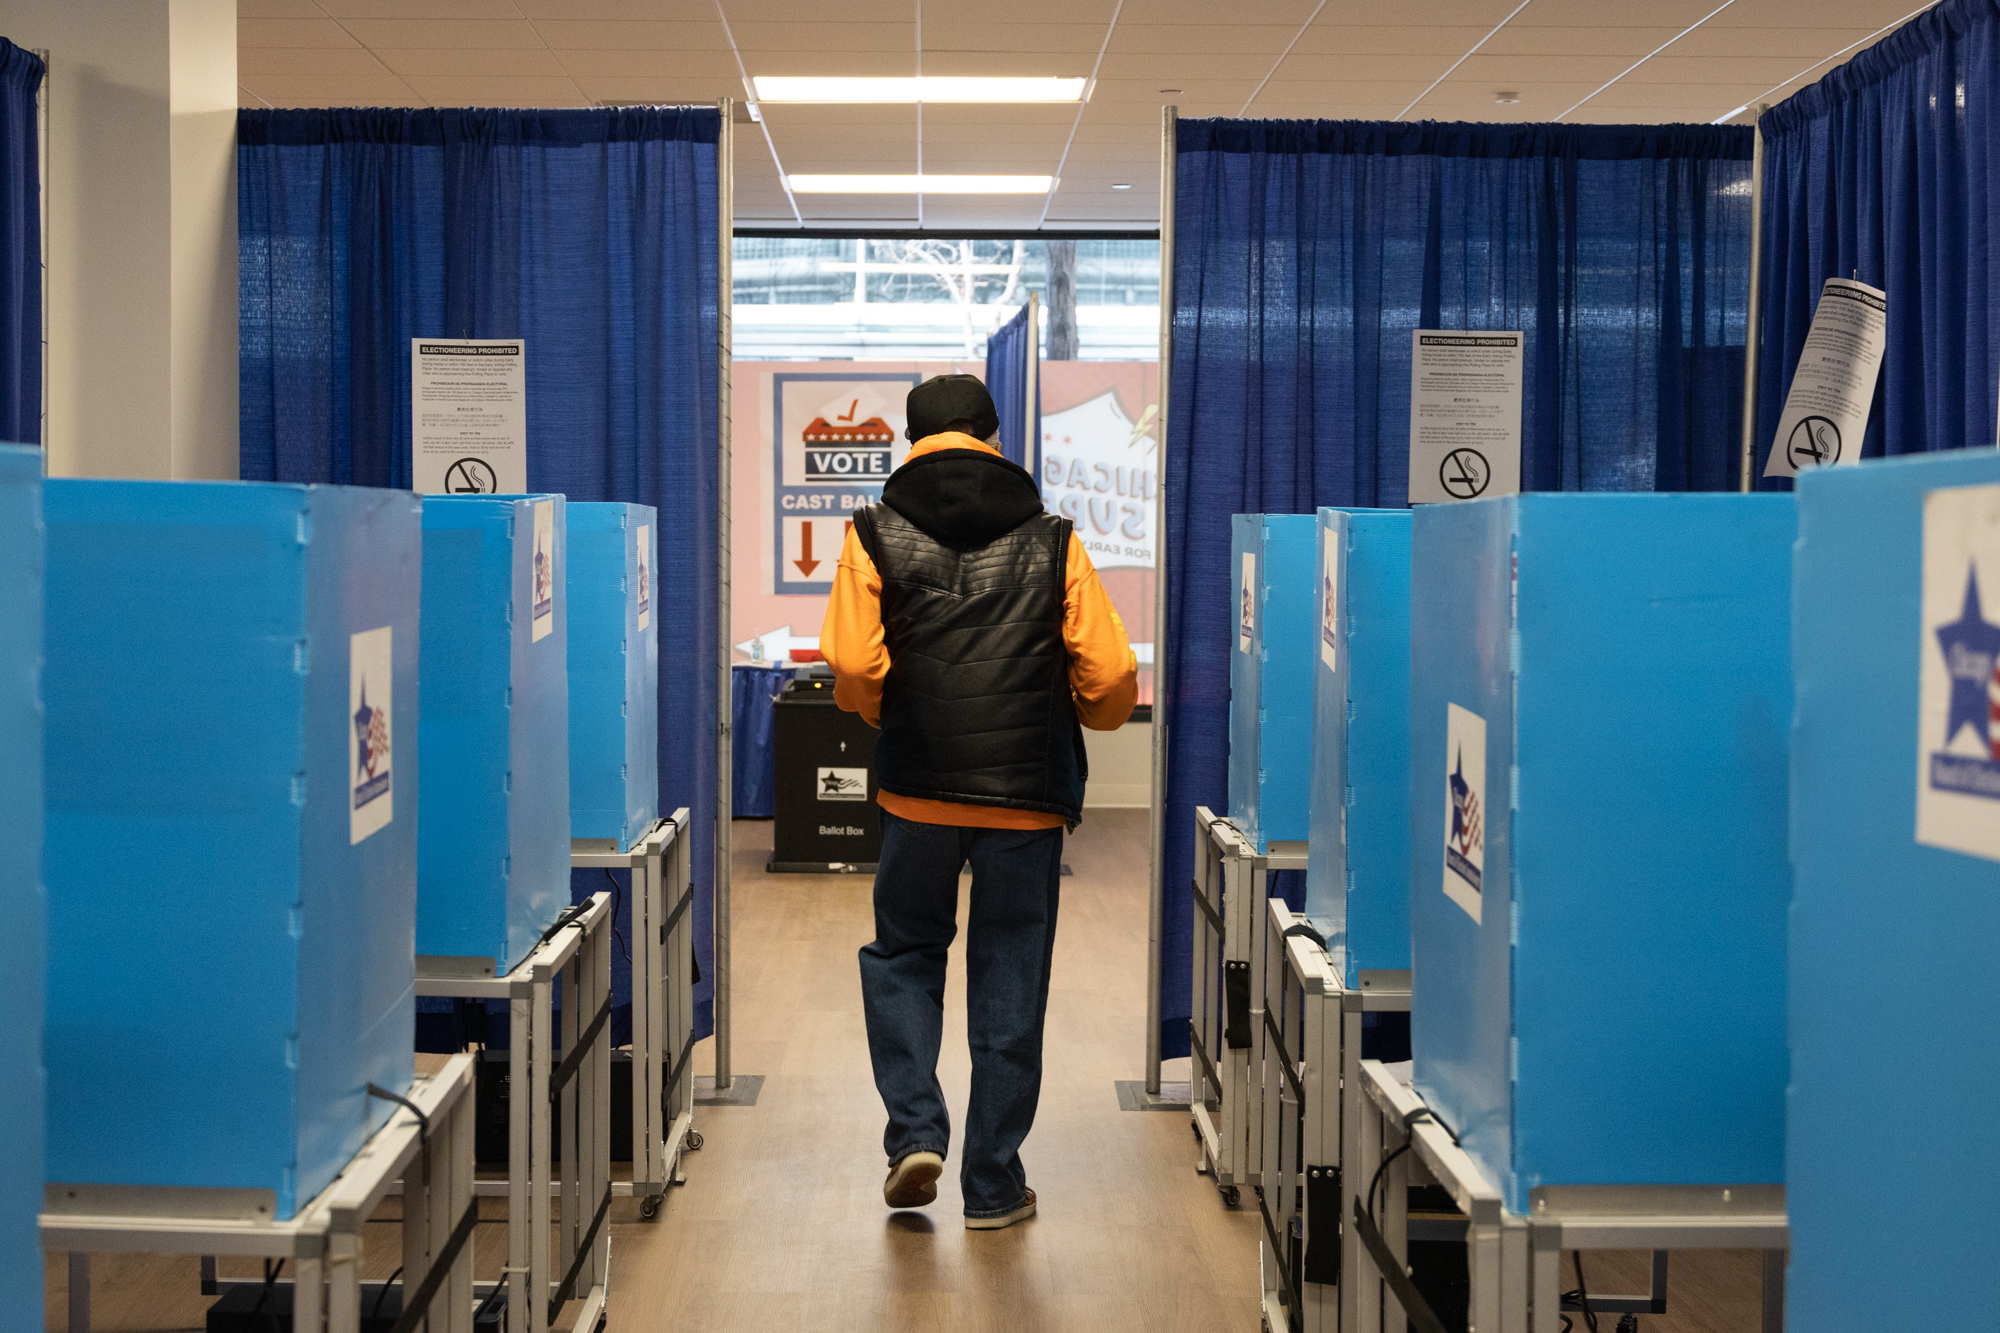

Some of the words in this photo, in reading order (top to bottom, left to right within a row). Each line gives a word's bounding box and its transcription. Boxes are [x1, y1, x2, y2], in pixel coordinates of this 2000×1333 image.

[1862, 294, 1886, 310] PROHIBITE
[1422, 337, 1475, 345] ELECTIONEERING
[1476, 338, 1516, 346] PROHIBITED
[422, 346, 477, 354] ELECTIONEERING
[813, 452, 884, 474] VOTE
[781, 494, 835, 510] CAST
[840, 494, 882, 510] BAL
[820, 825, 845, 835] Ballot
[846, 826, 865, 835] Box
